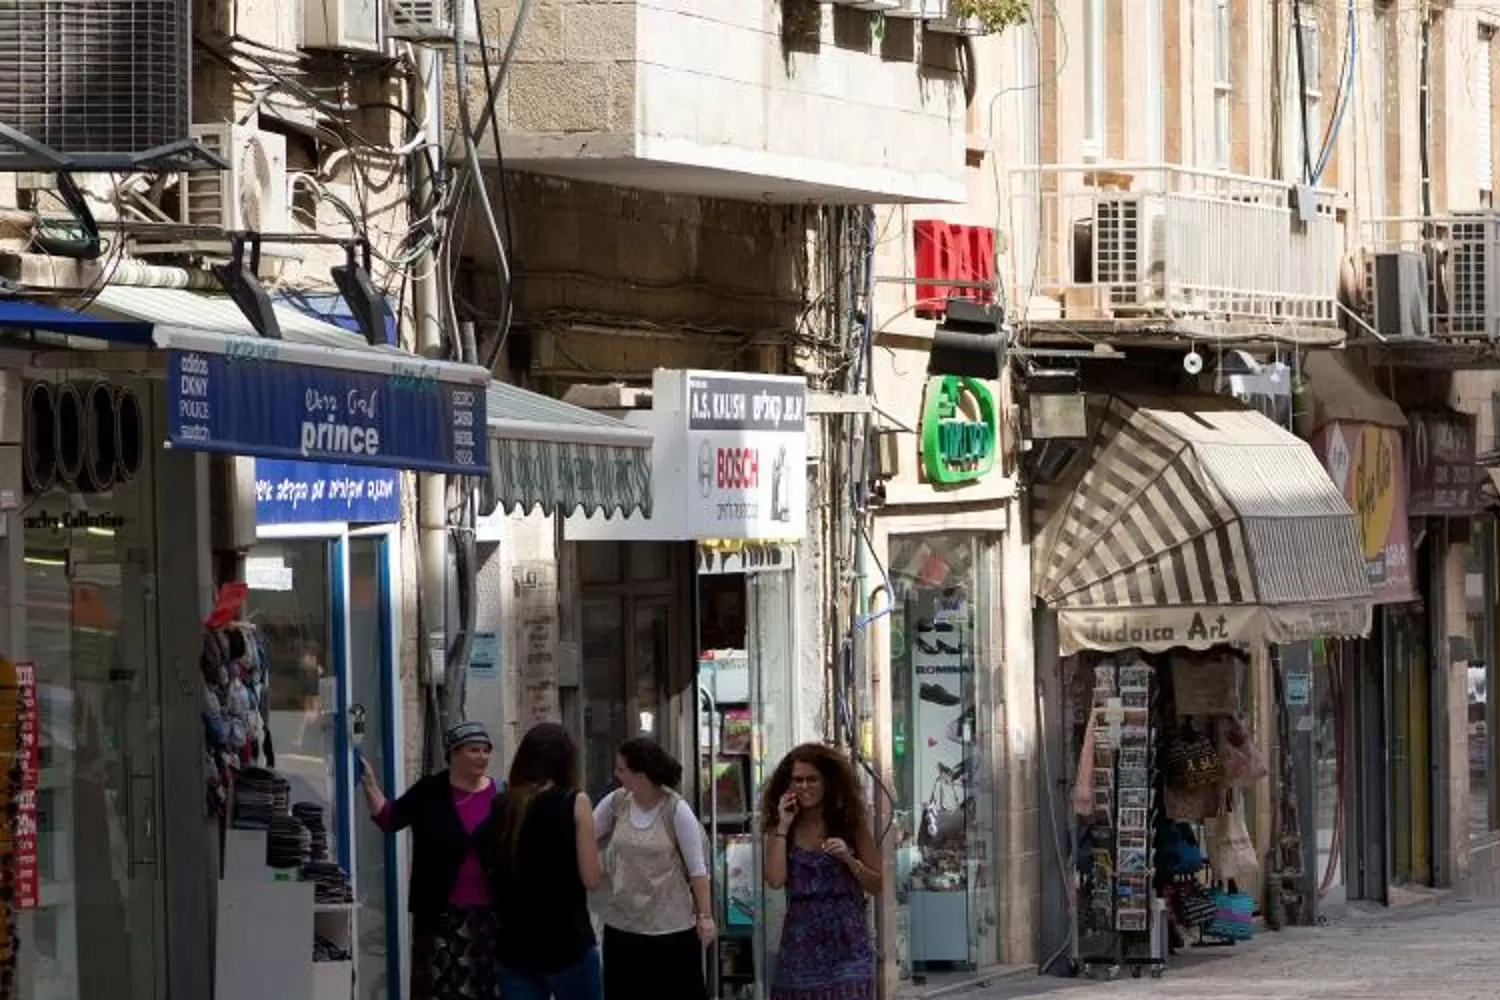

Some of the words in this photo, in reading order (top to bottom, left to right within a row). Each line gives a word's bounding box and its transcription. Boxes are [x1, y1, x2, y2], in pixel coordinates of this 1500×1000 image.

[181, 375, 208, 397] DKNY
[180, 399, 210, 419] POLICE
[301, 413, 379, 457] prince
[718, 448, 759, 489] BOSCH
[1187, 612, 1229, 640] Art
